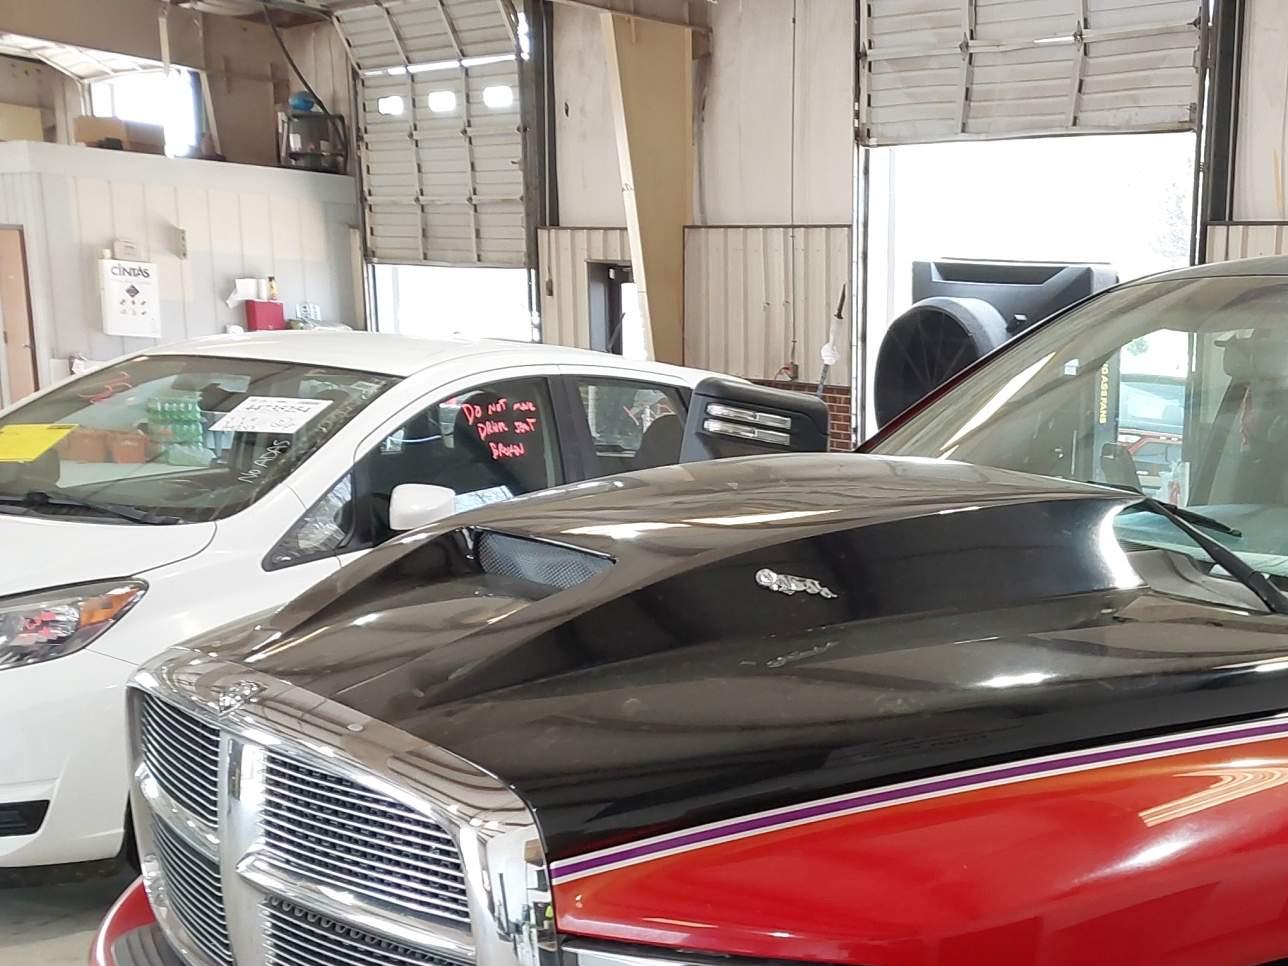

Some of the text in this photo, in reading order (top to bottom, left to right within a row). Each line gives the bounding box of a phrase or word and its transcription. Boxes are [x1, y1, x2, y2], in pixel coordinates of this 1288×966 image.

[111, 263, 150, 278] CINTAS
[462, 403, 482, 426] DO
[487, 398, 507, 415] NOT
